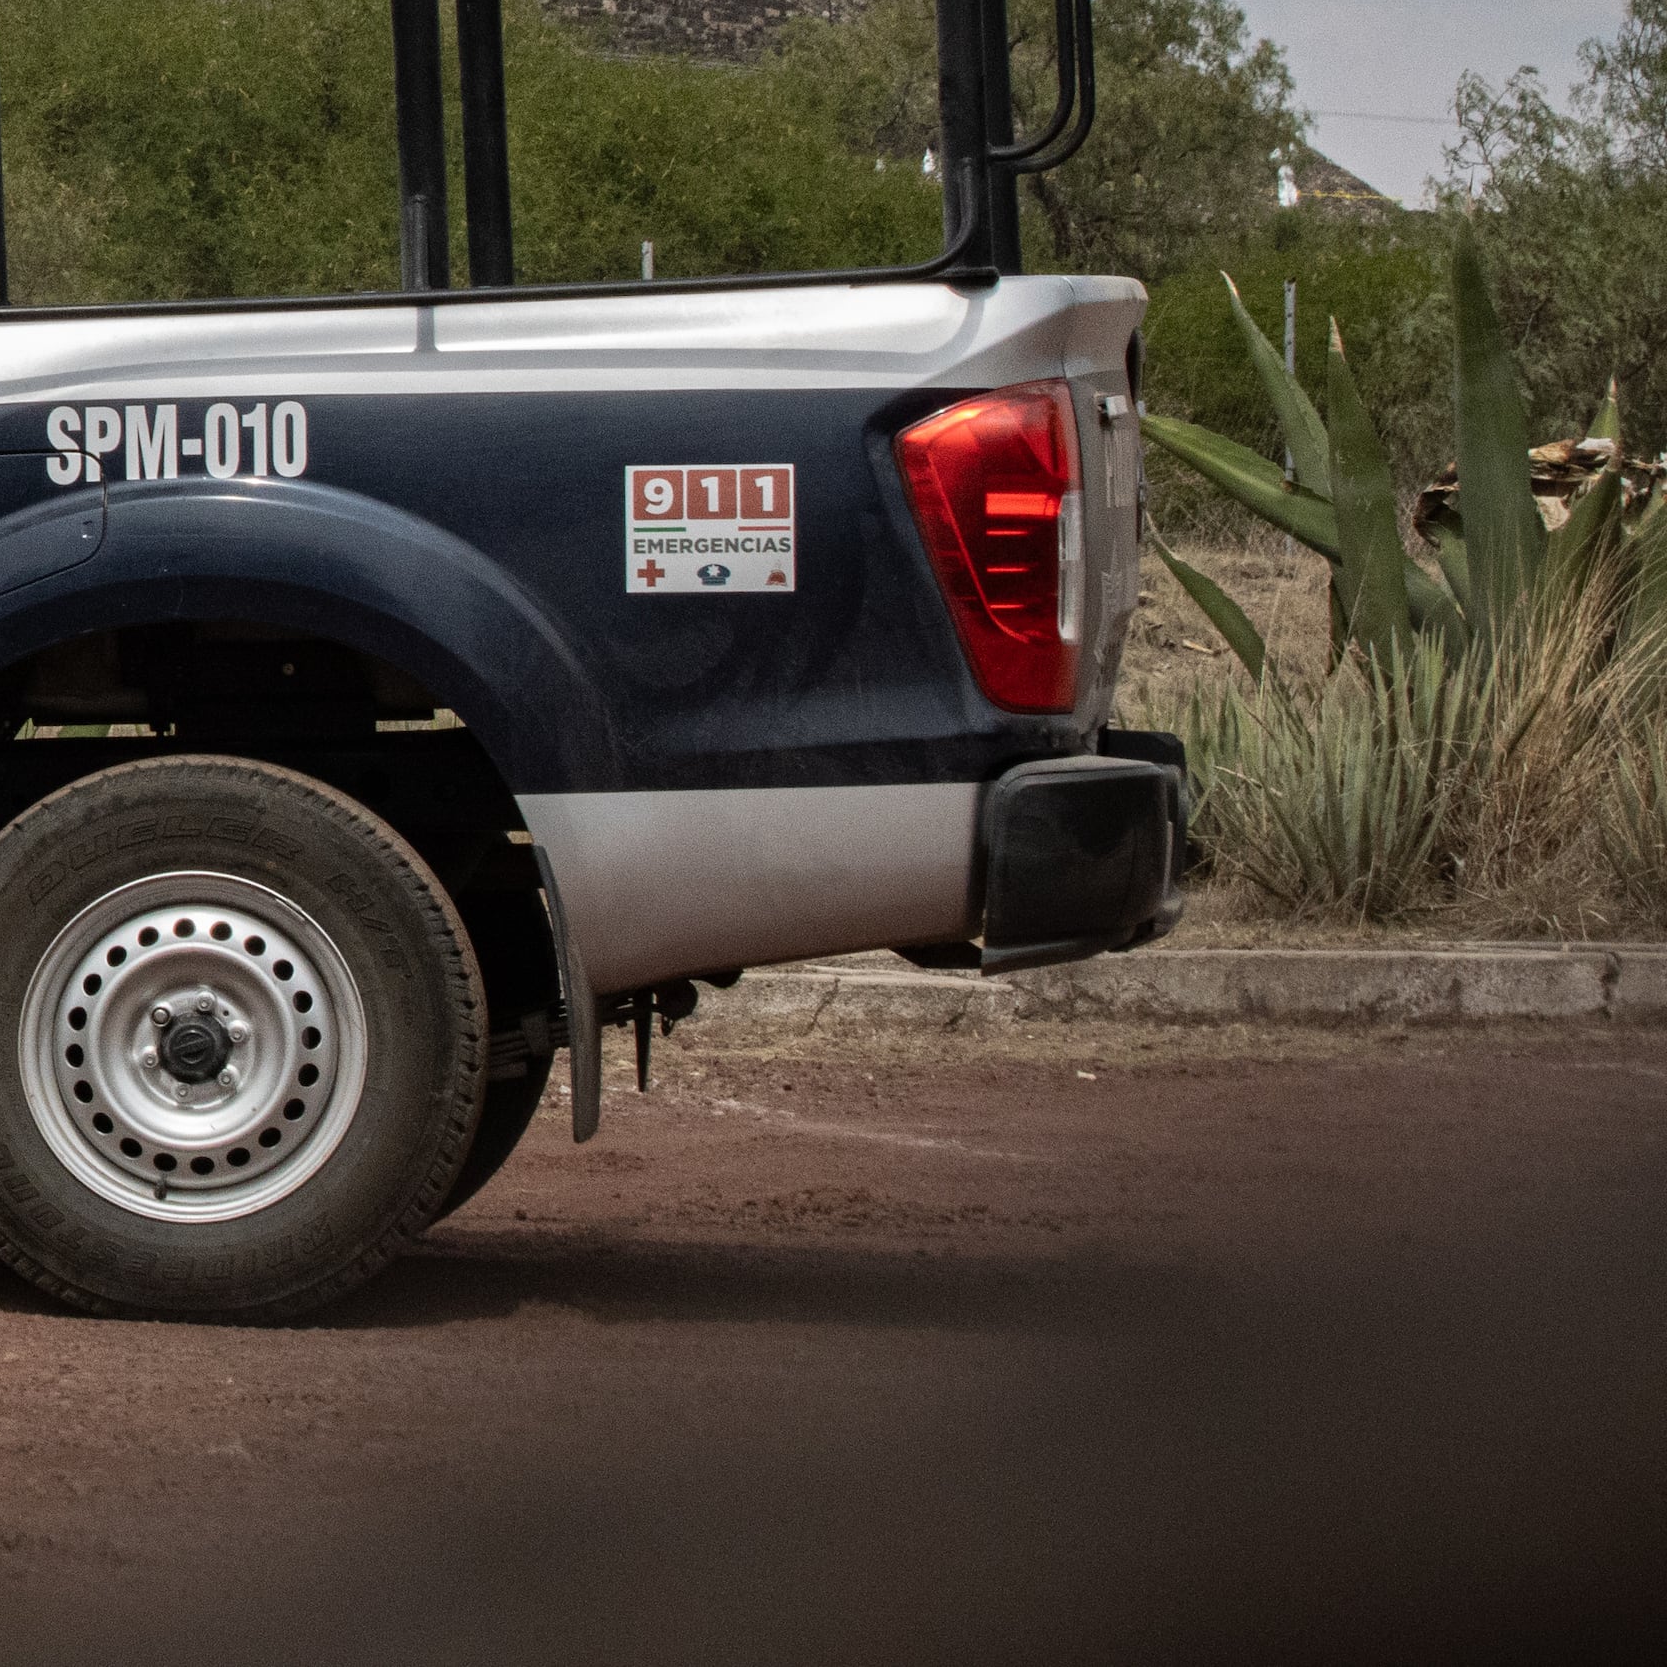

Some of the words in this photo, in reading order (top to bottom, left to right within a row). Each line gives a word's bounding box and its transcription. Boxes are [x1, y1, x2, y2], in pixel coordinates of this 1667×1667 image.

[46, 400, 308, 486] SPM-010
[644, 476, 774, 515] 911
[633, 537, 791, 554] EMERGENCIAS
